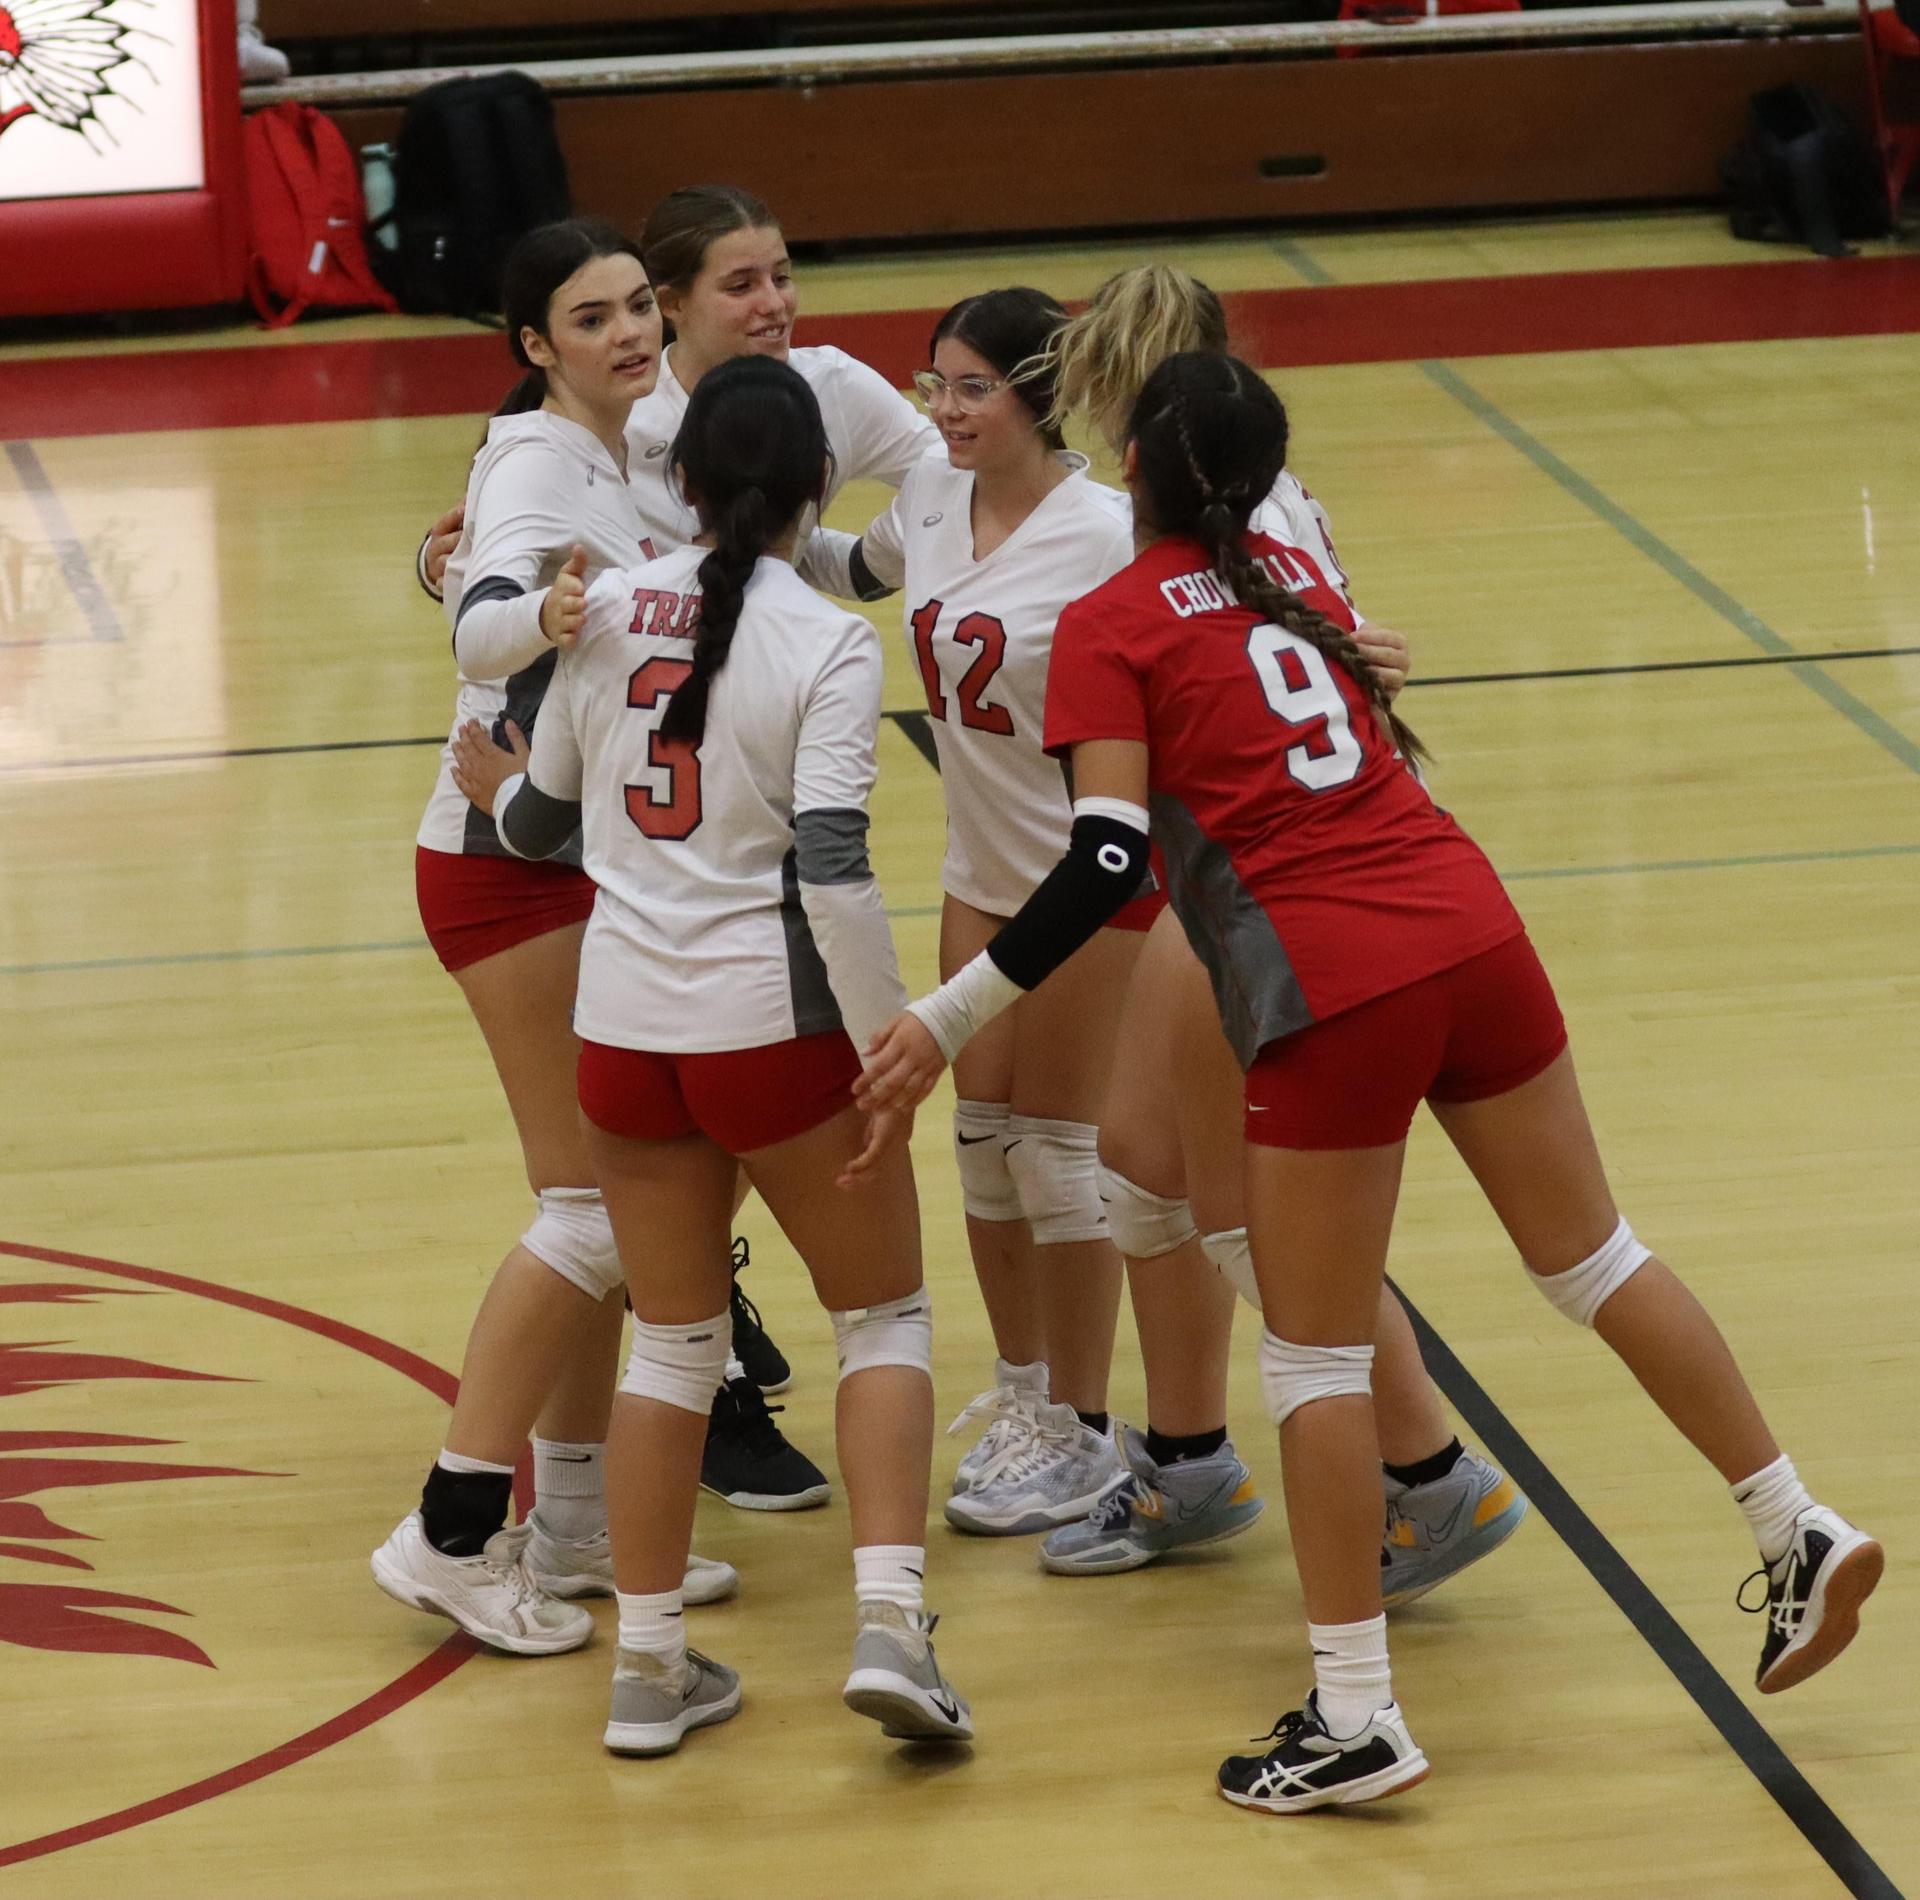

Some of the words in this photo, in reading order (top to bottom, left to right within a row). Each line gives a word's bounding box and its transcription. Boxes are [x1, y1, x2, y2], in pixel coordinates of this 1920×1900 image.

[624, 656, 704, 842] 3
[910, 598, 1015, 737] 12
[1246, 621, 1366, 796] 9
